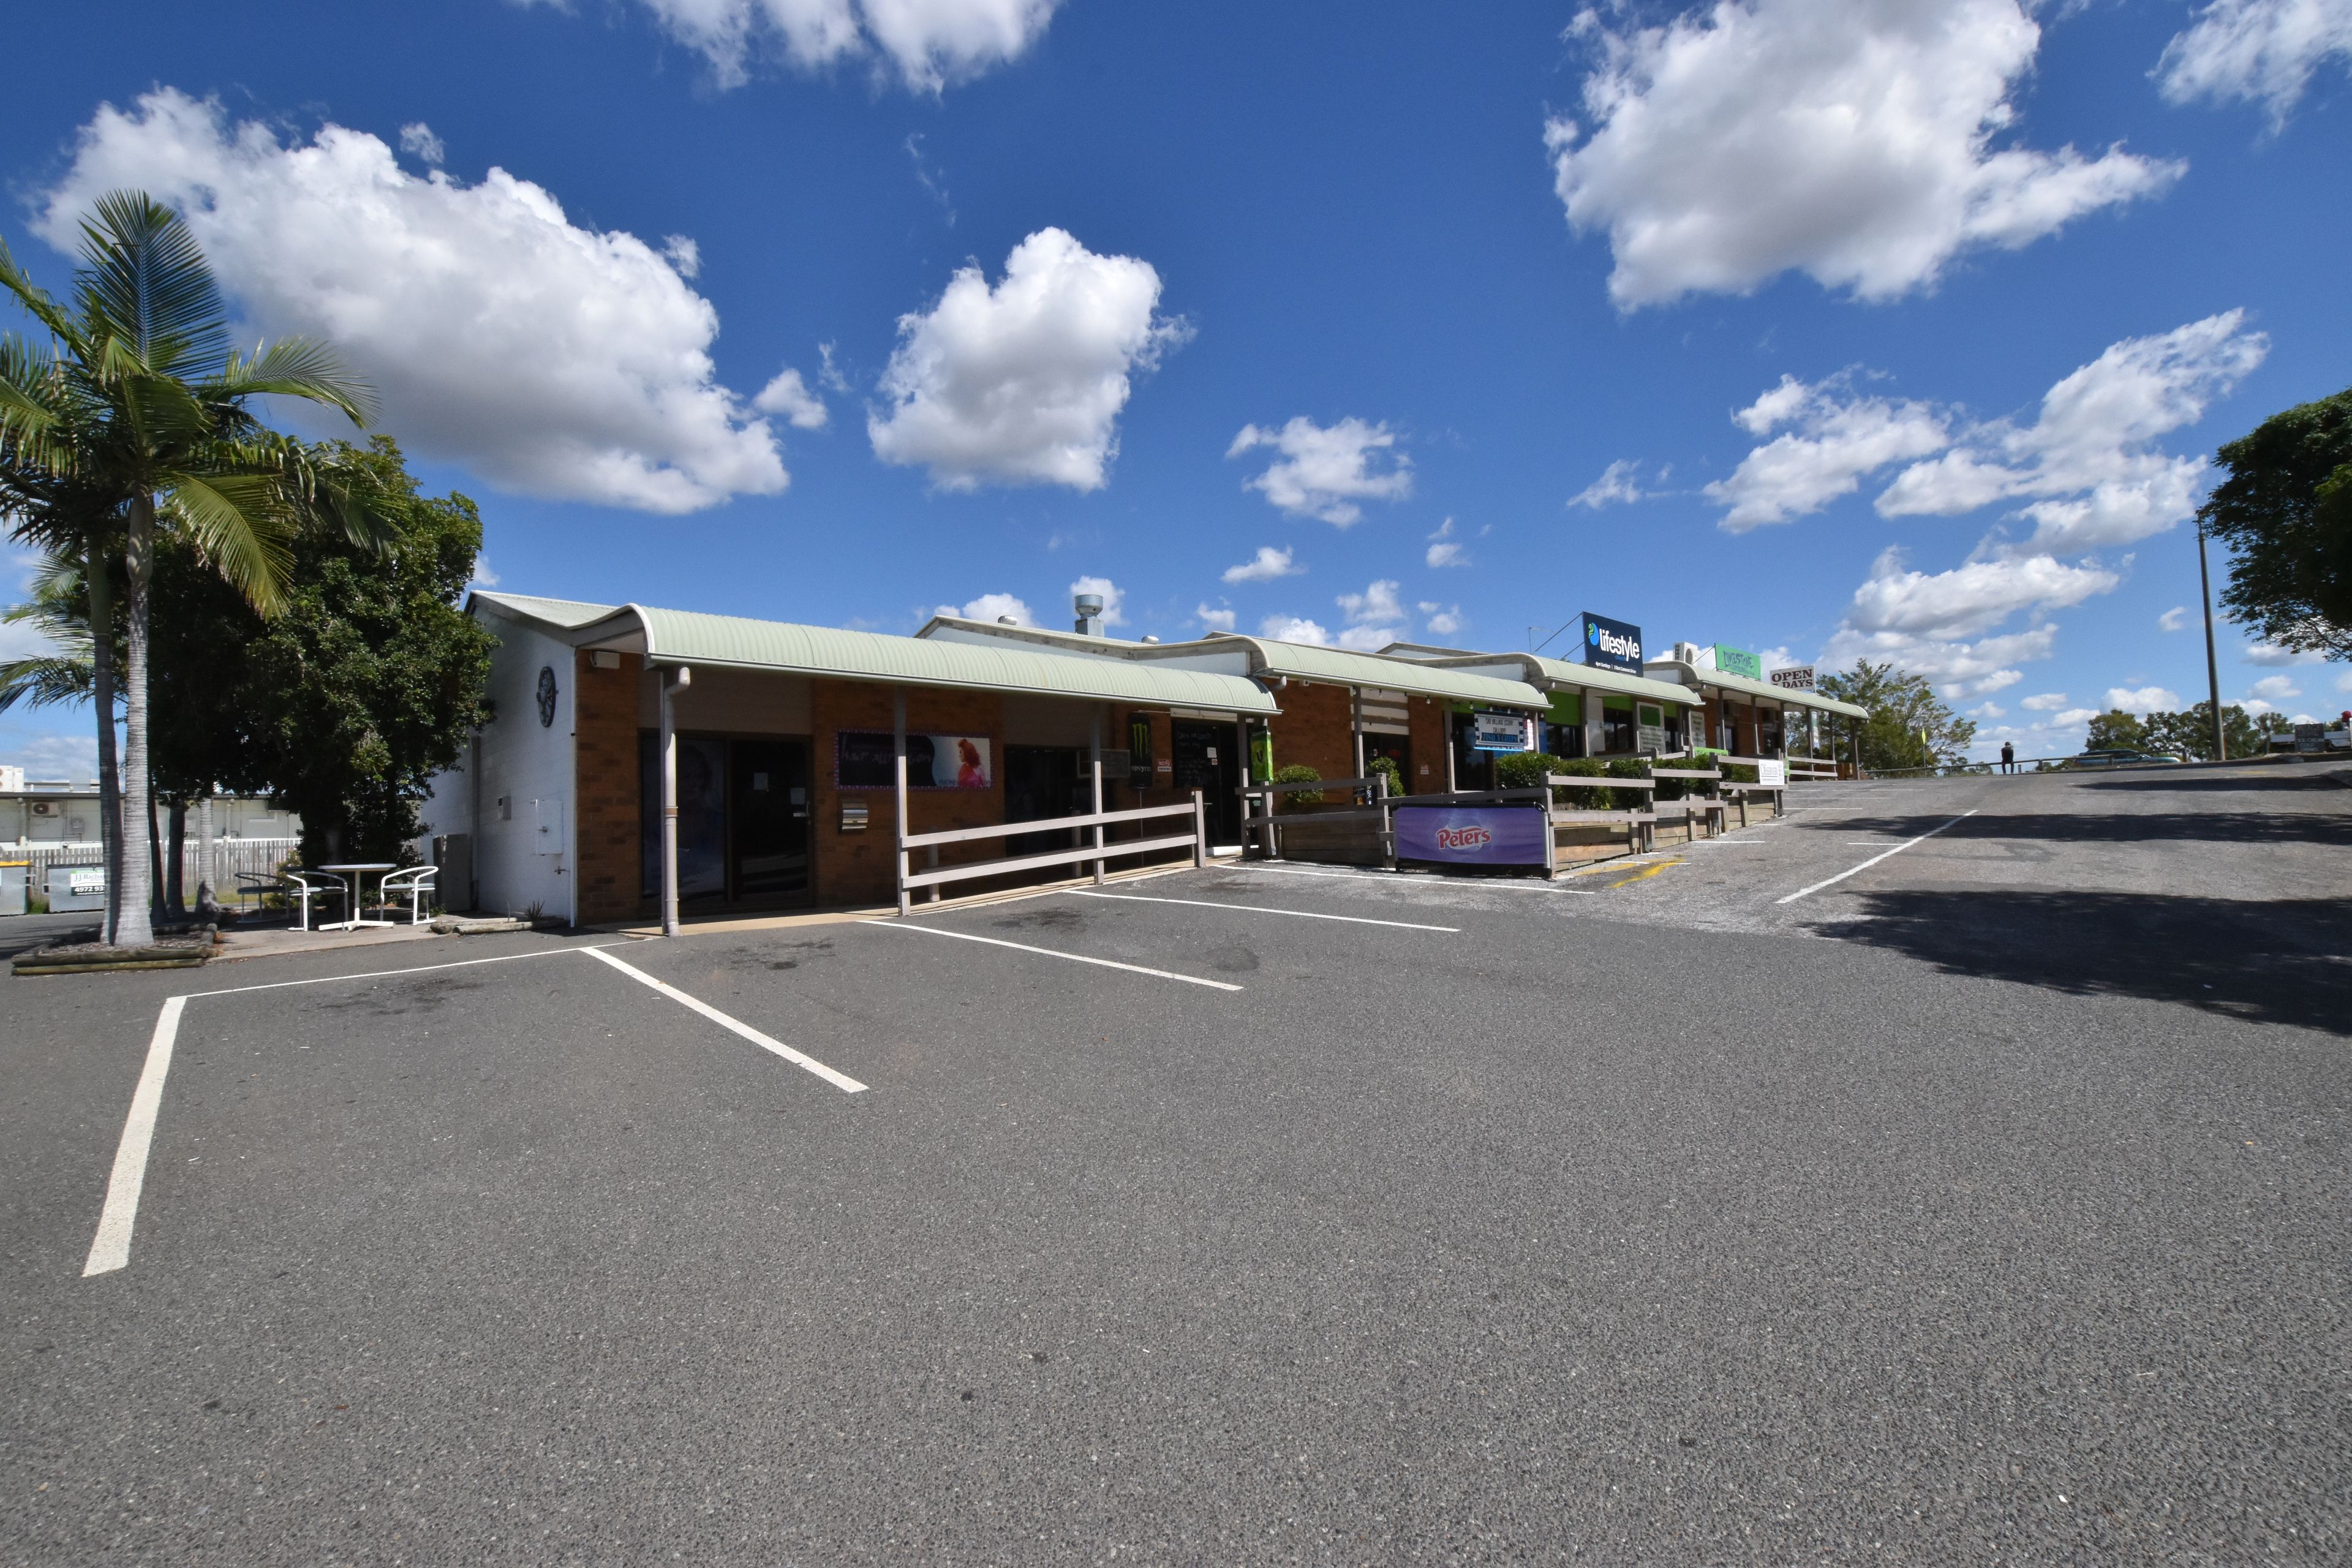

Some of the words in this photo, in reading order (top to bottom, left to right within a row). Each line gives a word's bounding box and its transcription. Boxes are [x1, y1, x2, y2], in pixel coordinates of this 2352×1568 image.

[1599, 628, 1639, 662] lifestyle
[1723, 649, 1755, 668] LIMESTONE
[1771, 668, 1813, 683] OPEN
[1782, 679, 1814, 689] DAYS
[1436, 827, 1491, 849] Peters
